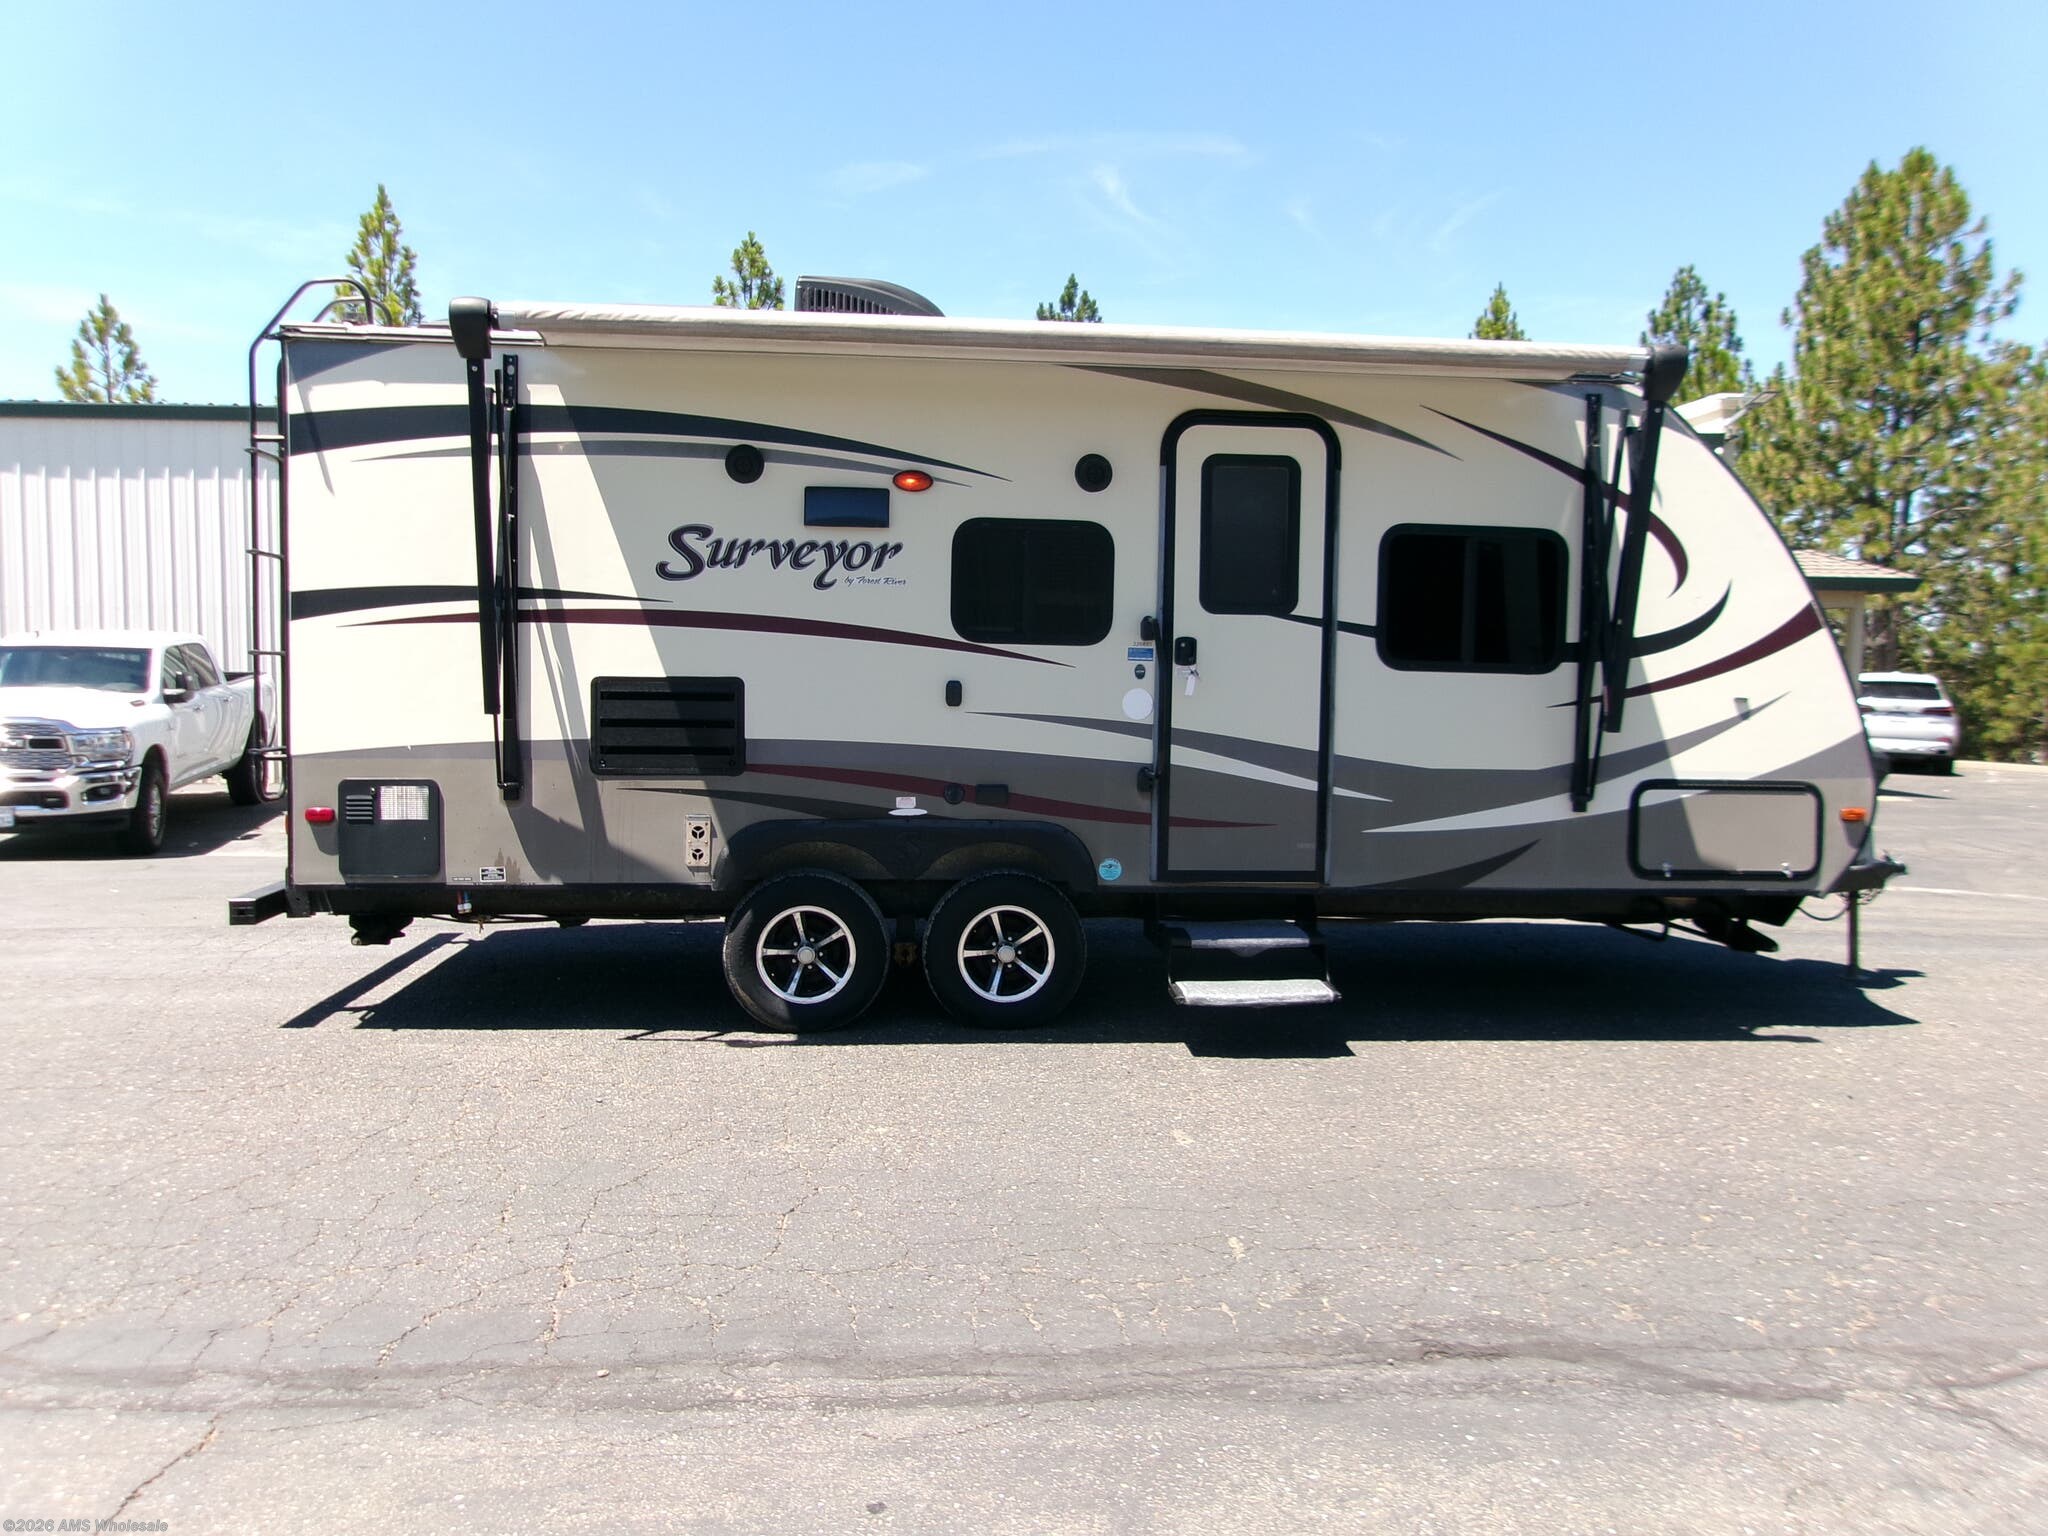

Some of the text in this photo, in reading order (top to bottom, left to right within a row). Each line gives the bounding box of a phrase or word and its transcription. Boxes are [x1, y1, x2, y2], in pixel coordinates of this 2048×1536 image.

[656, 523, 903, 590] Surveyor
[844, 575, 906, 587] by Forest River
